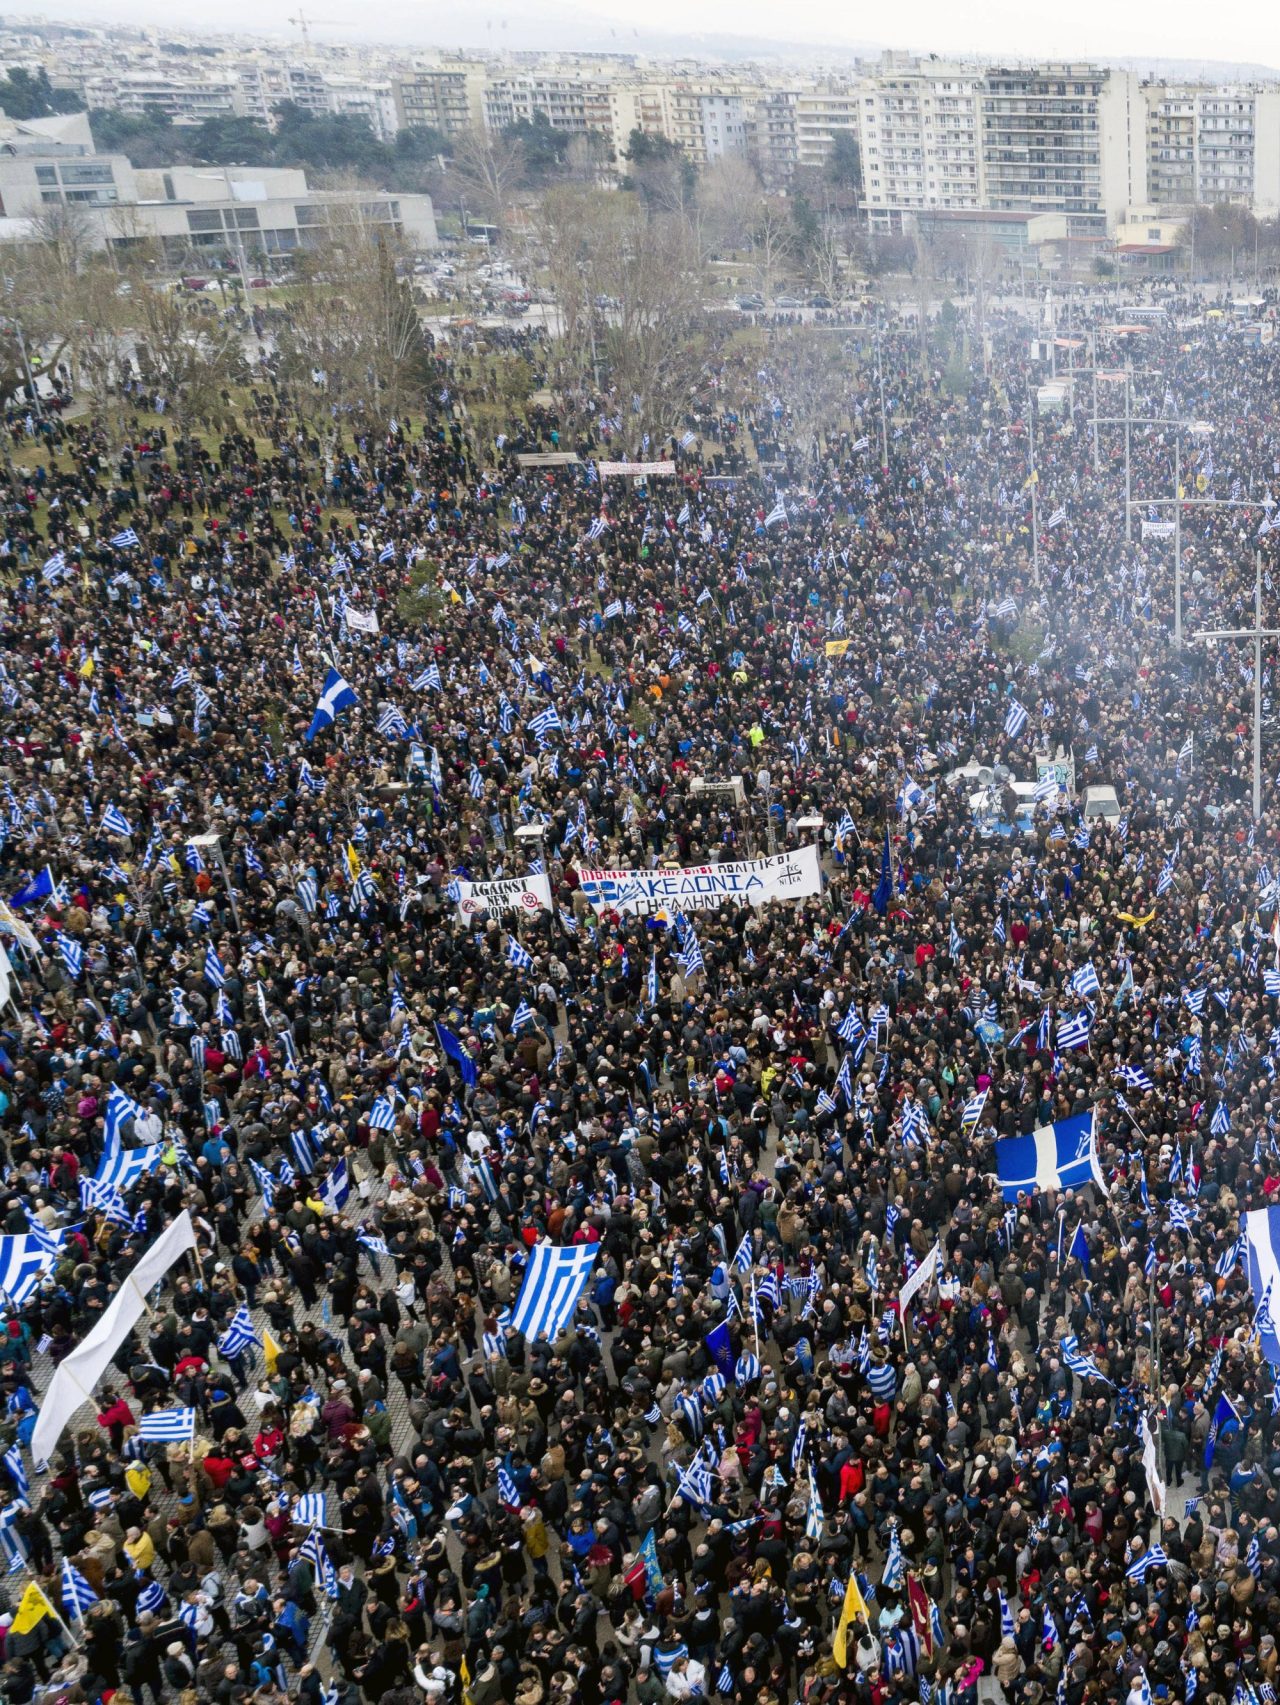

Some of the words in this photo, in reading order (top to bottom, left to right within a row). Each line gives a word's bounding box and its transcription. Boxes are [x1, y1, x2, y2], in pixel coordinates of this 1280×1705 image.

[717, 854, 790, 873] ΠΟΛΙΤΙΚΟΙ
[470, 879, 529, 897] AGAINST
[616, 875, 764, 900] ΜΑΚΕΔΟΝΙΑ
[486, 894, 510, 907] NEW
